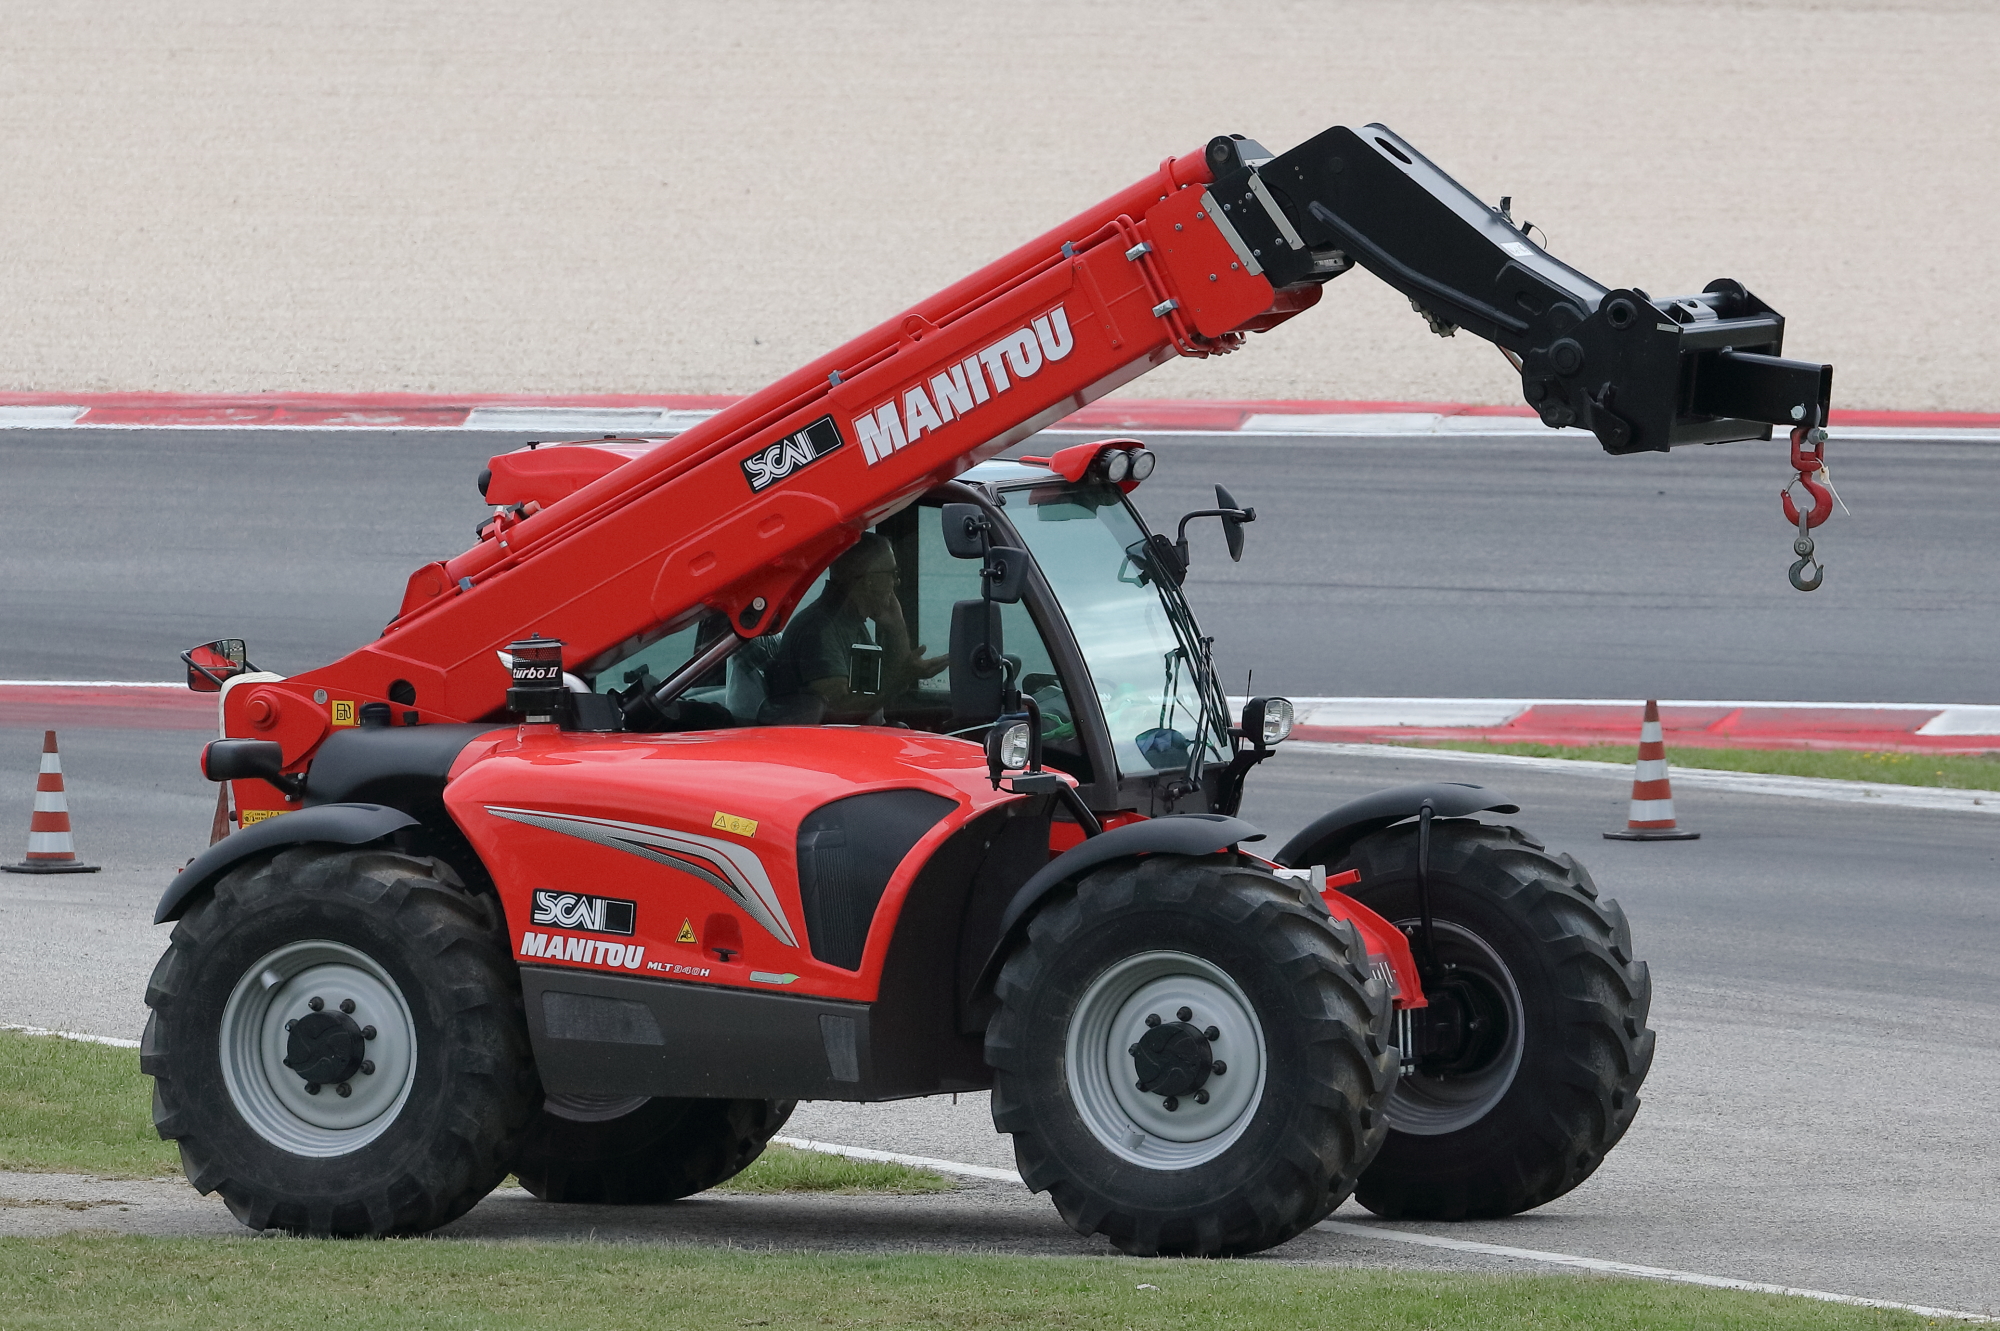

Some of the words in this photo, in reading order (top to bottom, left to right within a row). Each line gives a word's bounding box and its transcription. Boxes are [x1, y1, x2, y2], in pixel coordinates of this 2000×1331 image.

[853, 305, 1074, 467] MANITOU
[513, 667, 545, 678] turbo
[546, 667, 558, 677] II
[520, 932, 645, 969] MANITOU
[646, 961, 673, 972] MLT
